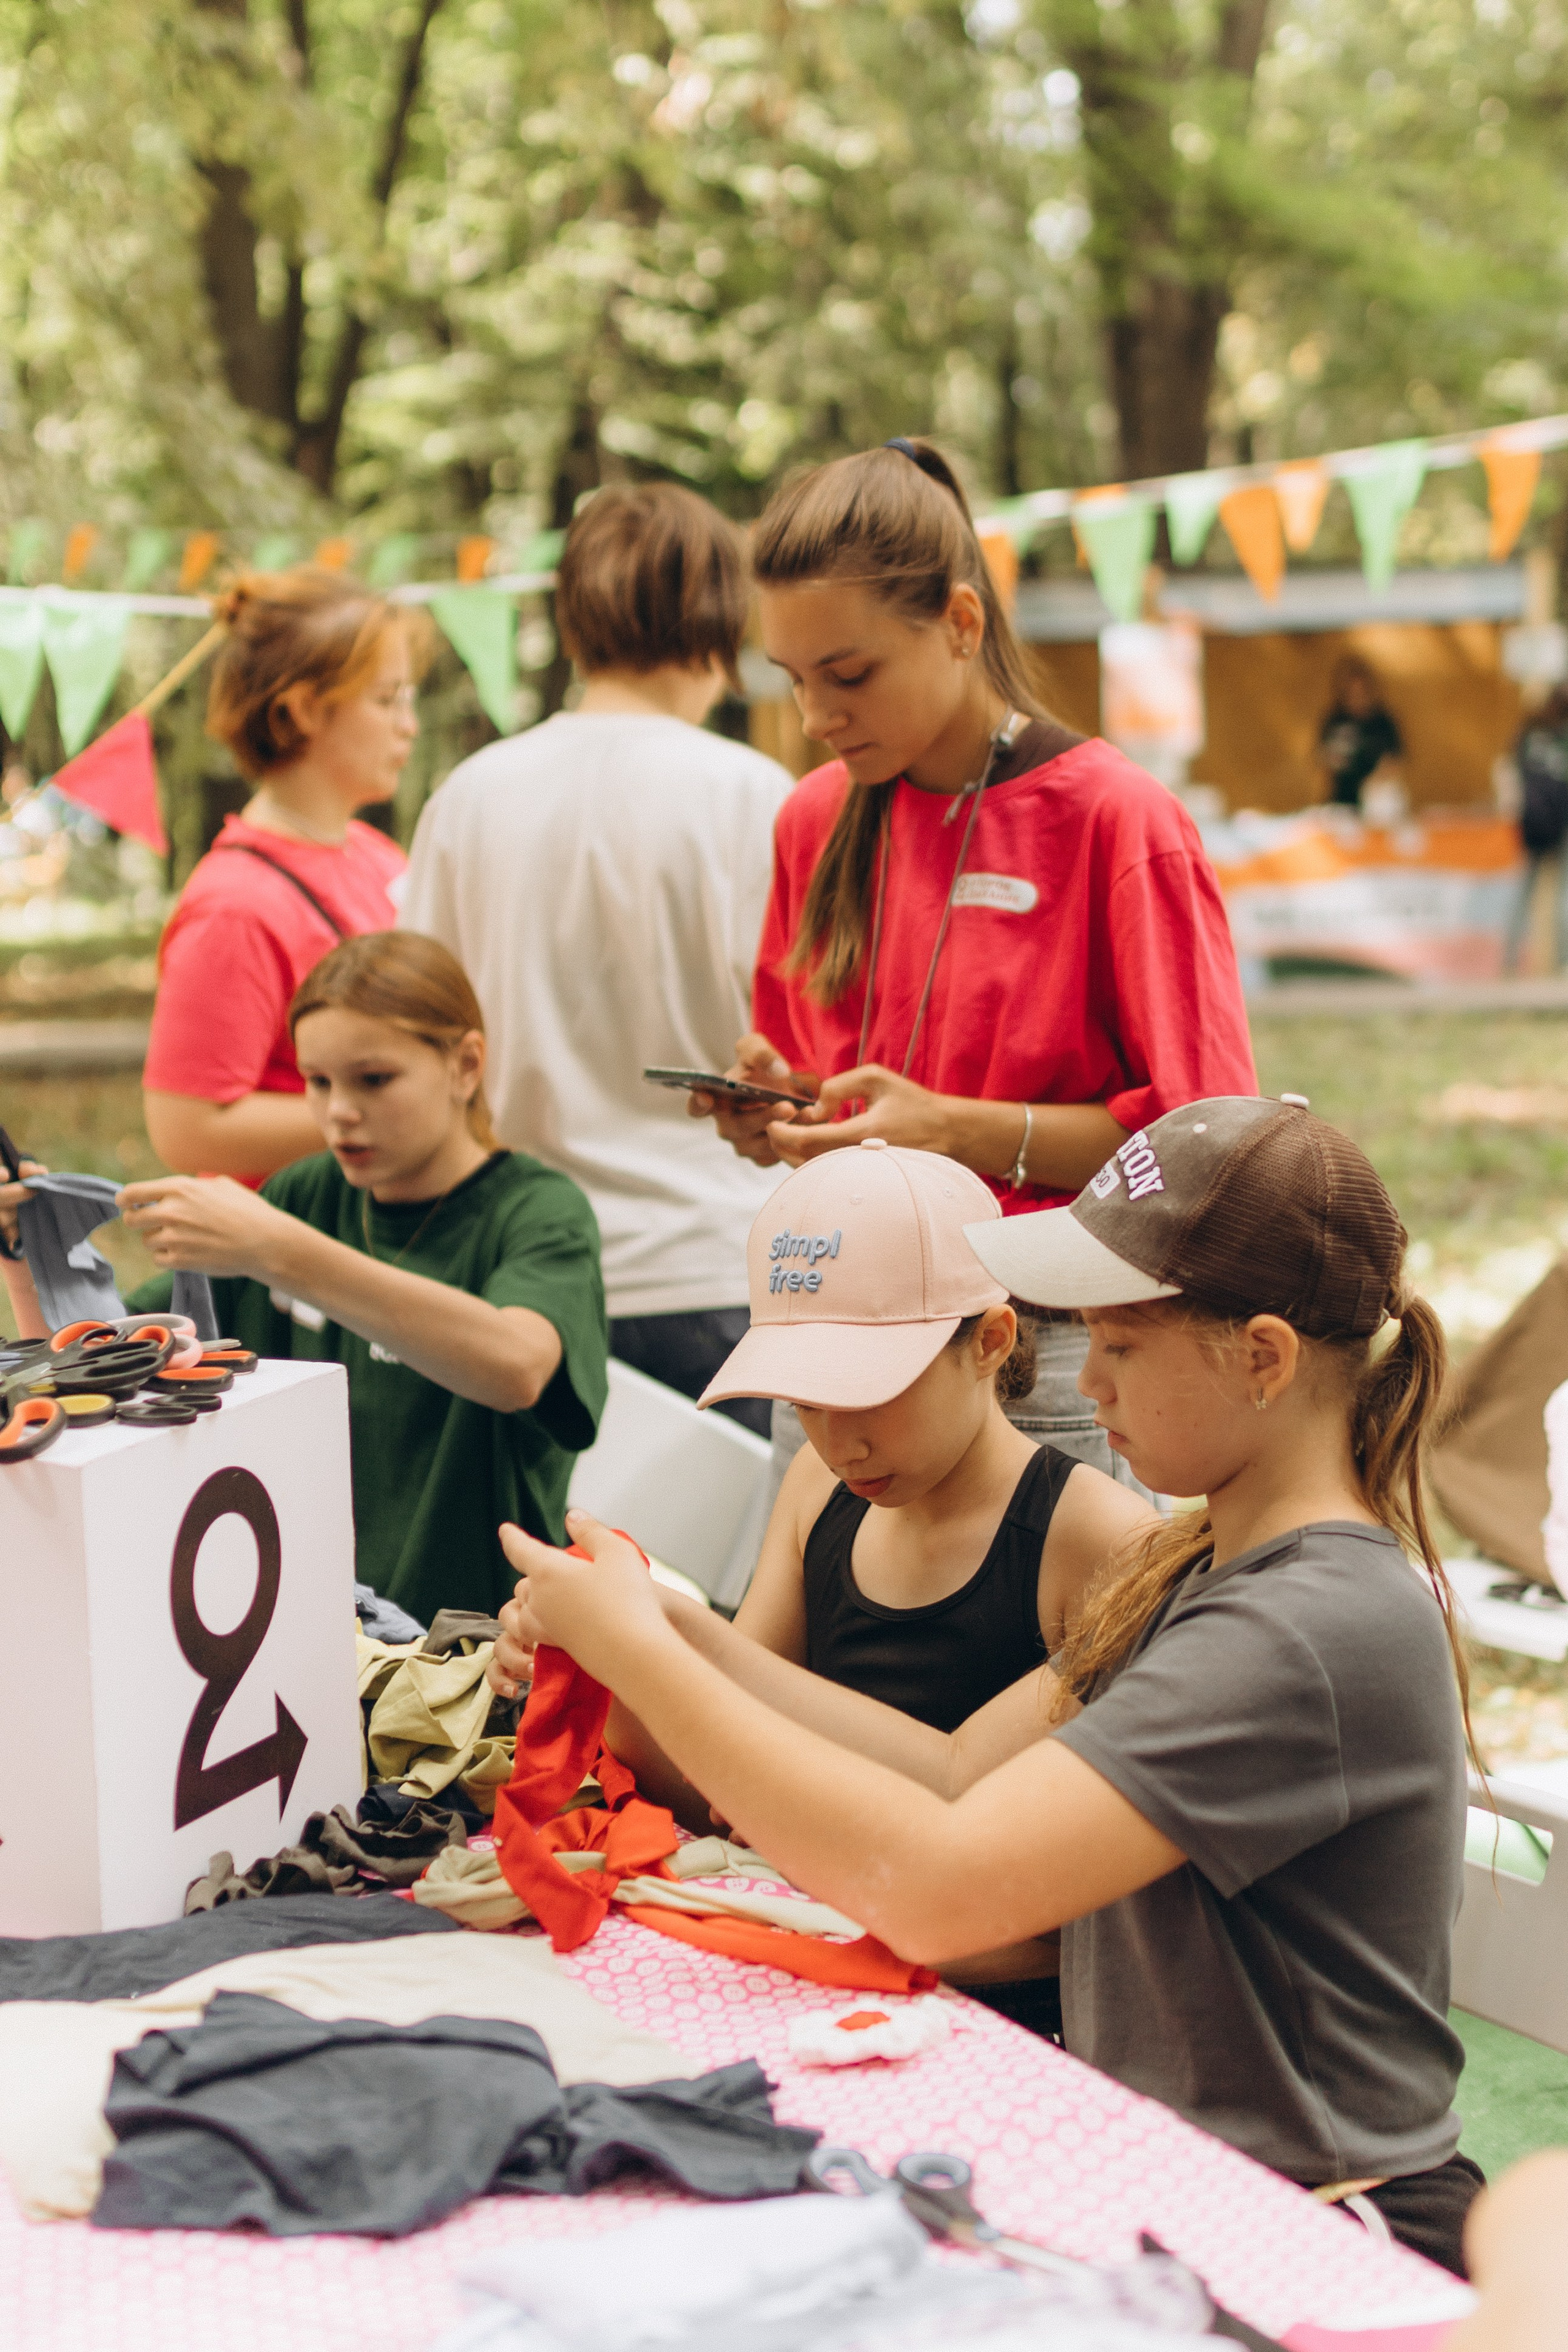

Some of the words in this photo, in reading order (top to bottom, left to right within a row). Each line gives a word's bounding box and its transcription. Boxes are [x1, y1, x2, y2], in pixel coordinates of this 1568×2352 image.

[769, 1227, 842, 1265] simpl
[769, 1263, 823, 1294] free
[170, 1466, 309, 1832] 2
